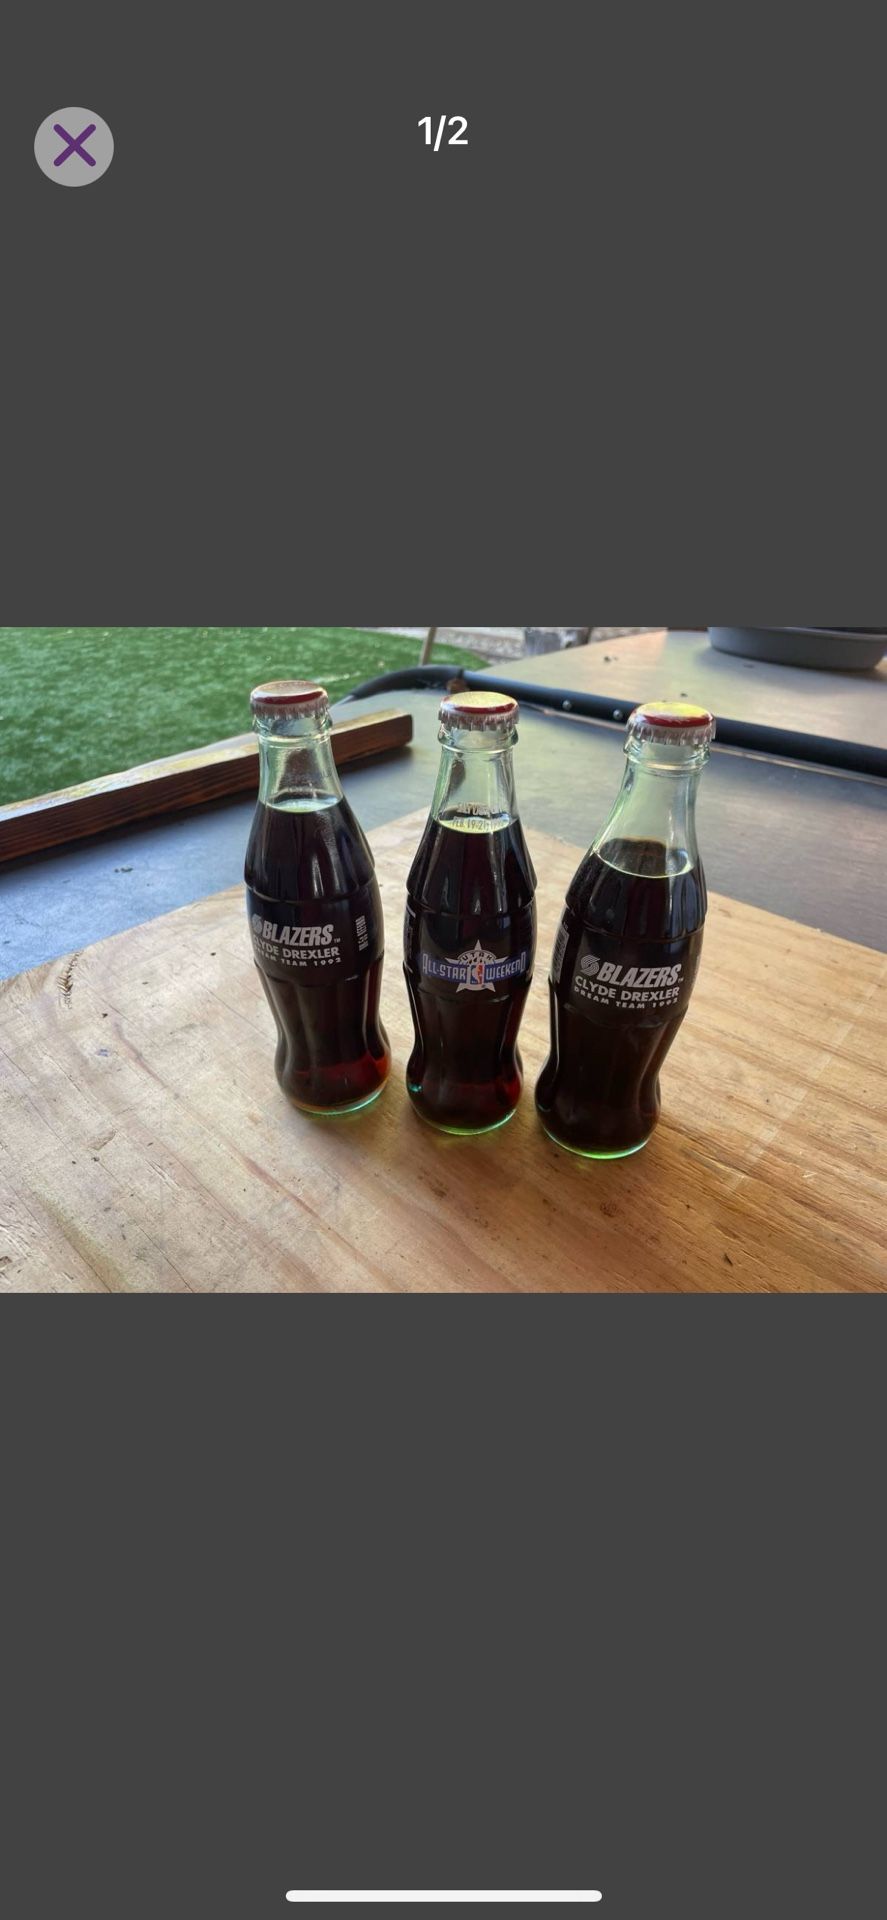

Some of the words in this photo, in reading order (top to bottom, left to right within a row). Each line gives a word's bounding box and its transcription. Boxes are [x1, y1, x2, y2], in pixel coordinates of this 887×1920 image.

[262, 920, 334, 947] BLAZERS
[281, 958, 307, 967] TEAM
[314, 957, 341, 967] 1992
[282, 946, 340, 960] DREXLER
[463, 952, 493, 961] UTAH
[422, 953, 466, 981] ALL-STAR
[485, 951, 527, 981] WEEKEND
[597, 961, 682, 988] BLAZERS
[574, 986, 609, 1005] DREAM
[615, 1000, 645, 1009] TEAM
[575, 975, 617, 998] CLYDE
[620, 986, 680, 1002] DREXLER
